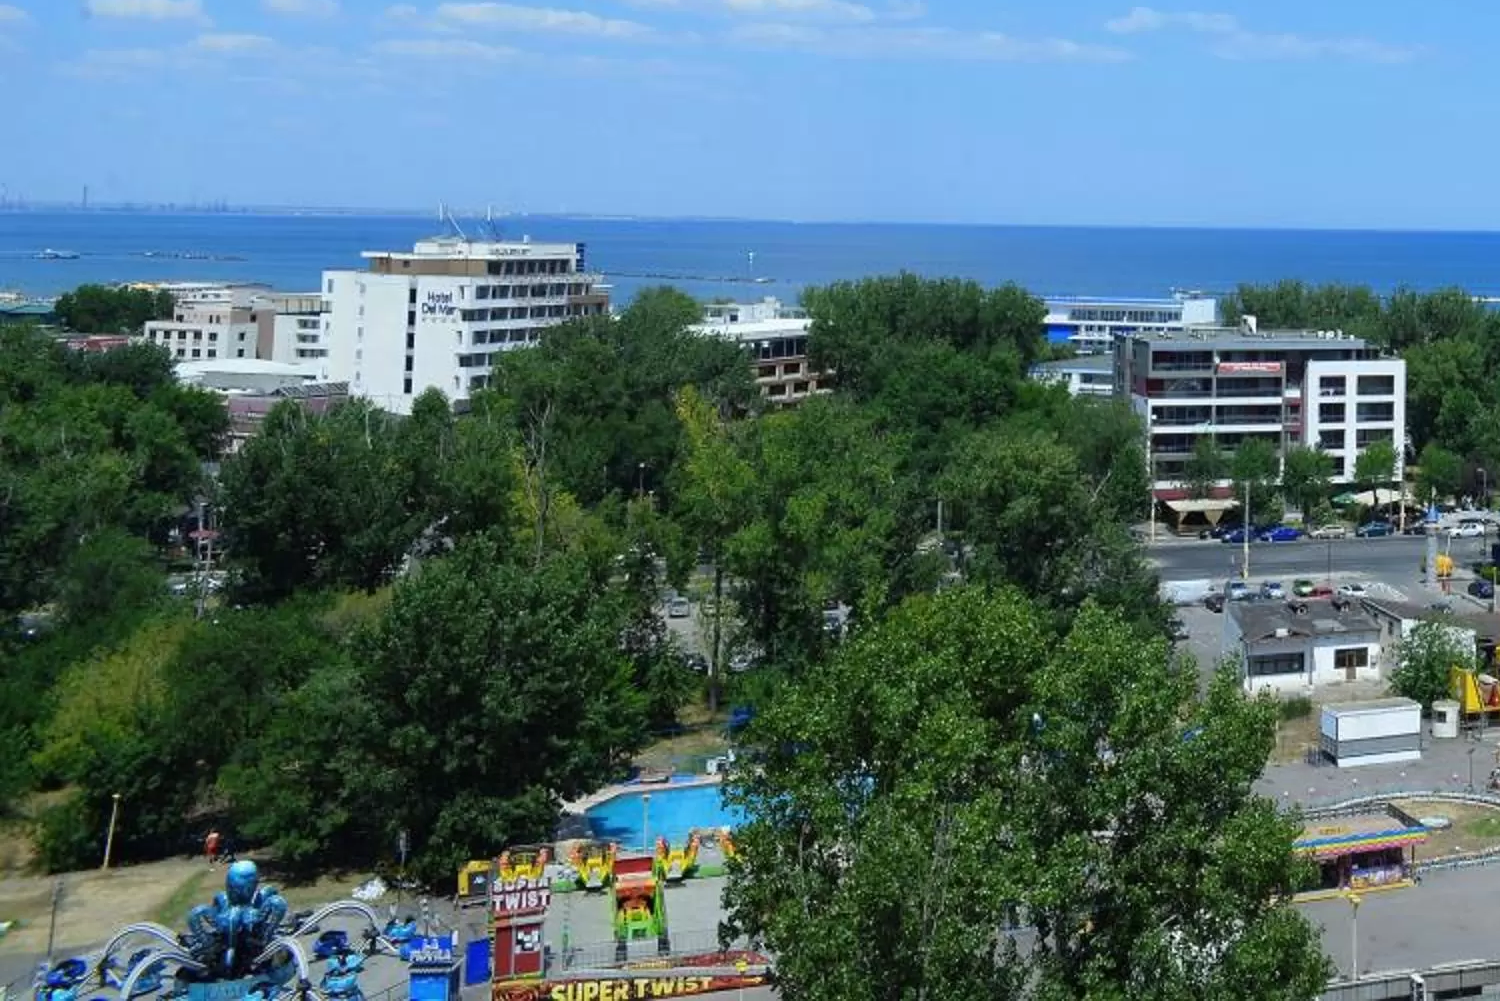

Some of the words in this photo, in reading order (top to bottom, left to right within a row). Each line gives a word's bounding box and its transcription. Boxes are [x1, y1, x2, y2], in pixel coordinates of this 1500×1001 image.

[427, 290, 453, 303] Hotel
[421, 302, 437, 315] Del
[438, 304, 457, 315] Mar
[493, 877, 549, 892] SUPER
[492, 890, 550, 911] TWIST
[551, 978, 629, 1001] SUPER
[634, 976, 713, 998] TWIST
